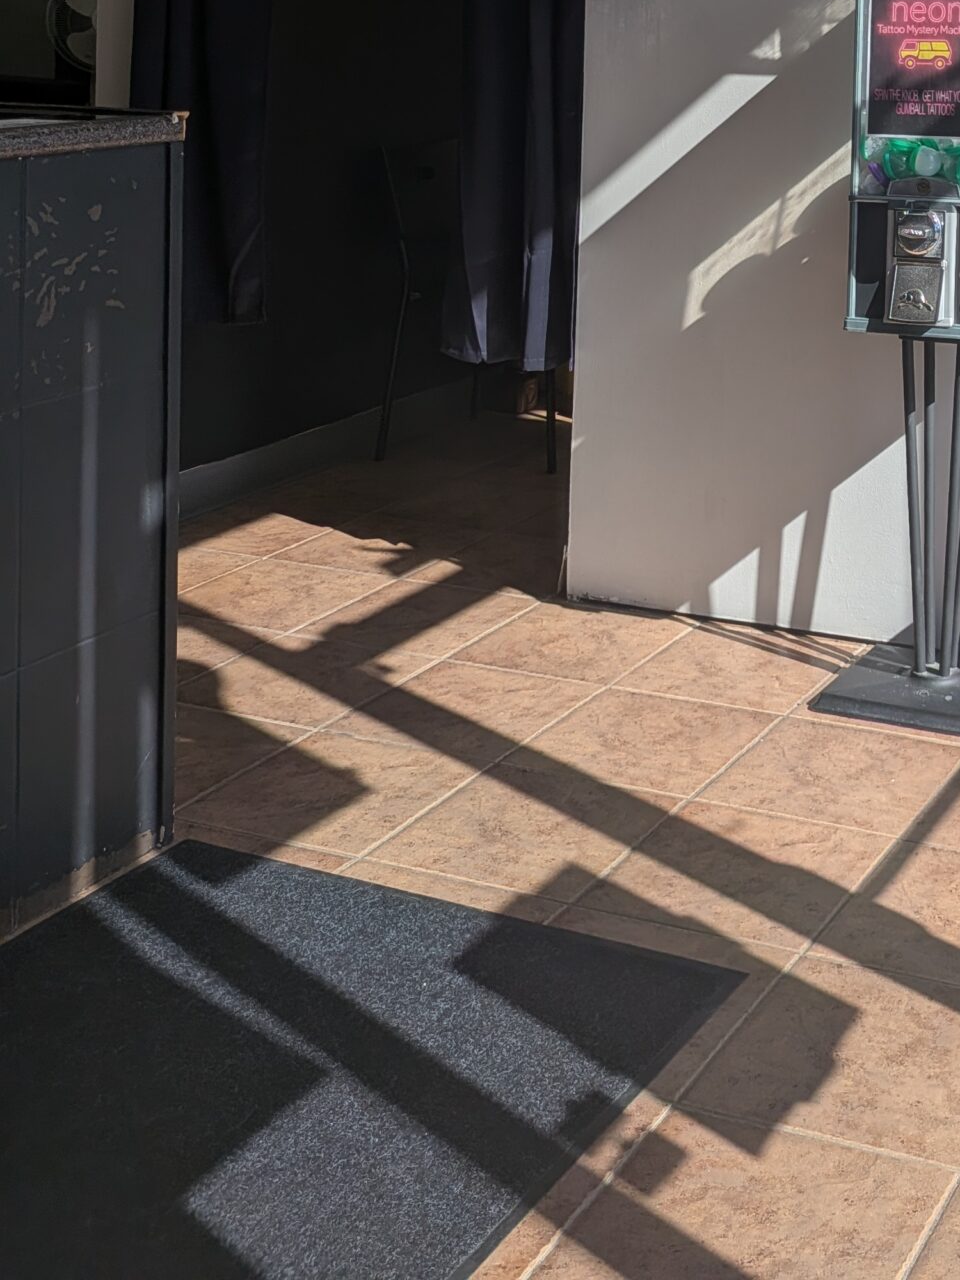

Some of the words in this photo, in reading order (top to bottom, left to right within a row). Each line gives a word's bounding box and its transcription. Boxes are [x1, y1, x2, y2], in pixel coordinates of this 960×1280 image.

[877, 24, 905, 34] Tattoo
[906, 25, 939, 36] Mystery
[874, 88, 888, 101] SPIN
[889, 89, 901, 101] THE
[922, 90, 934, 102] GET
[935, 90, 952, 103] WHAT
[895, 103, 926, 115] GUMBALL
[926, 103, 955, 116] TATTOOS
